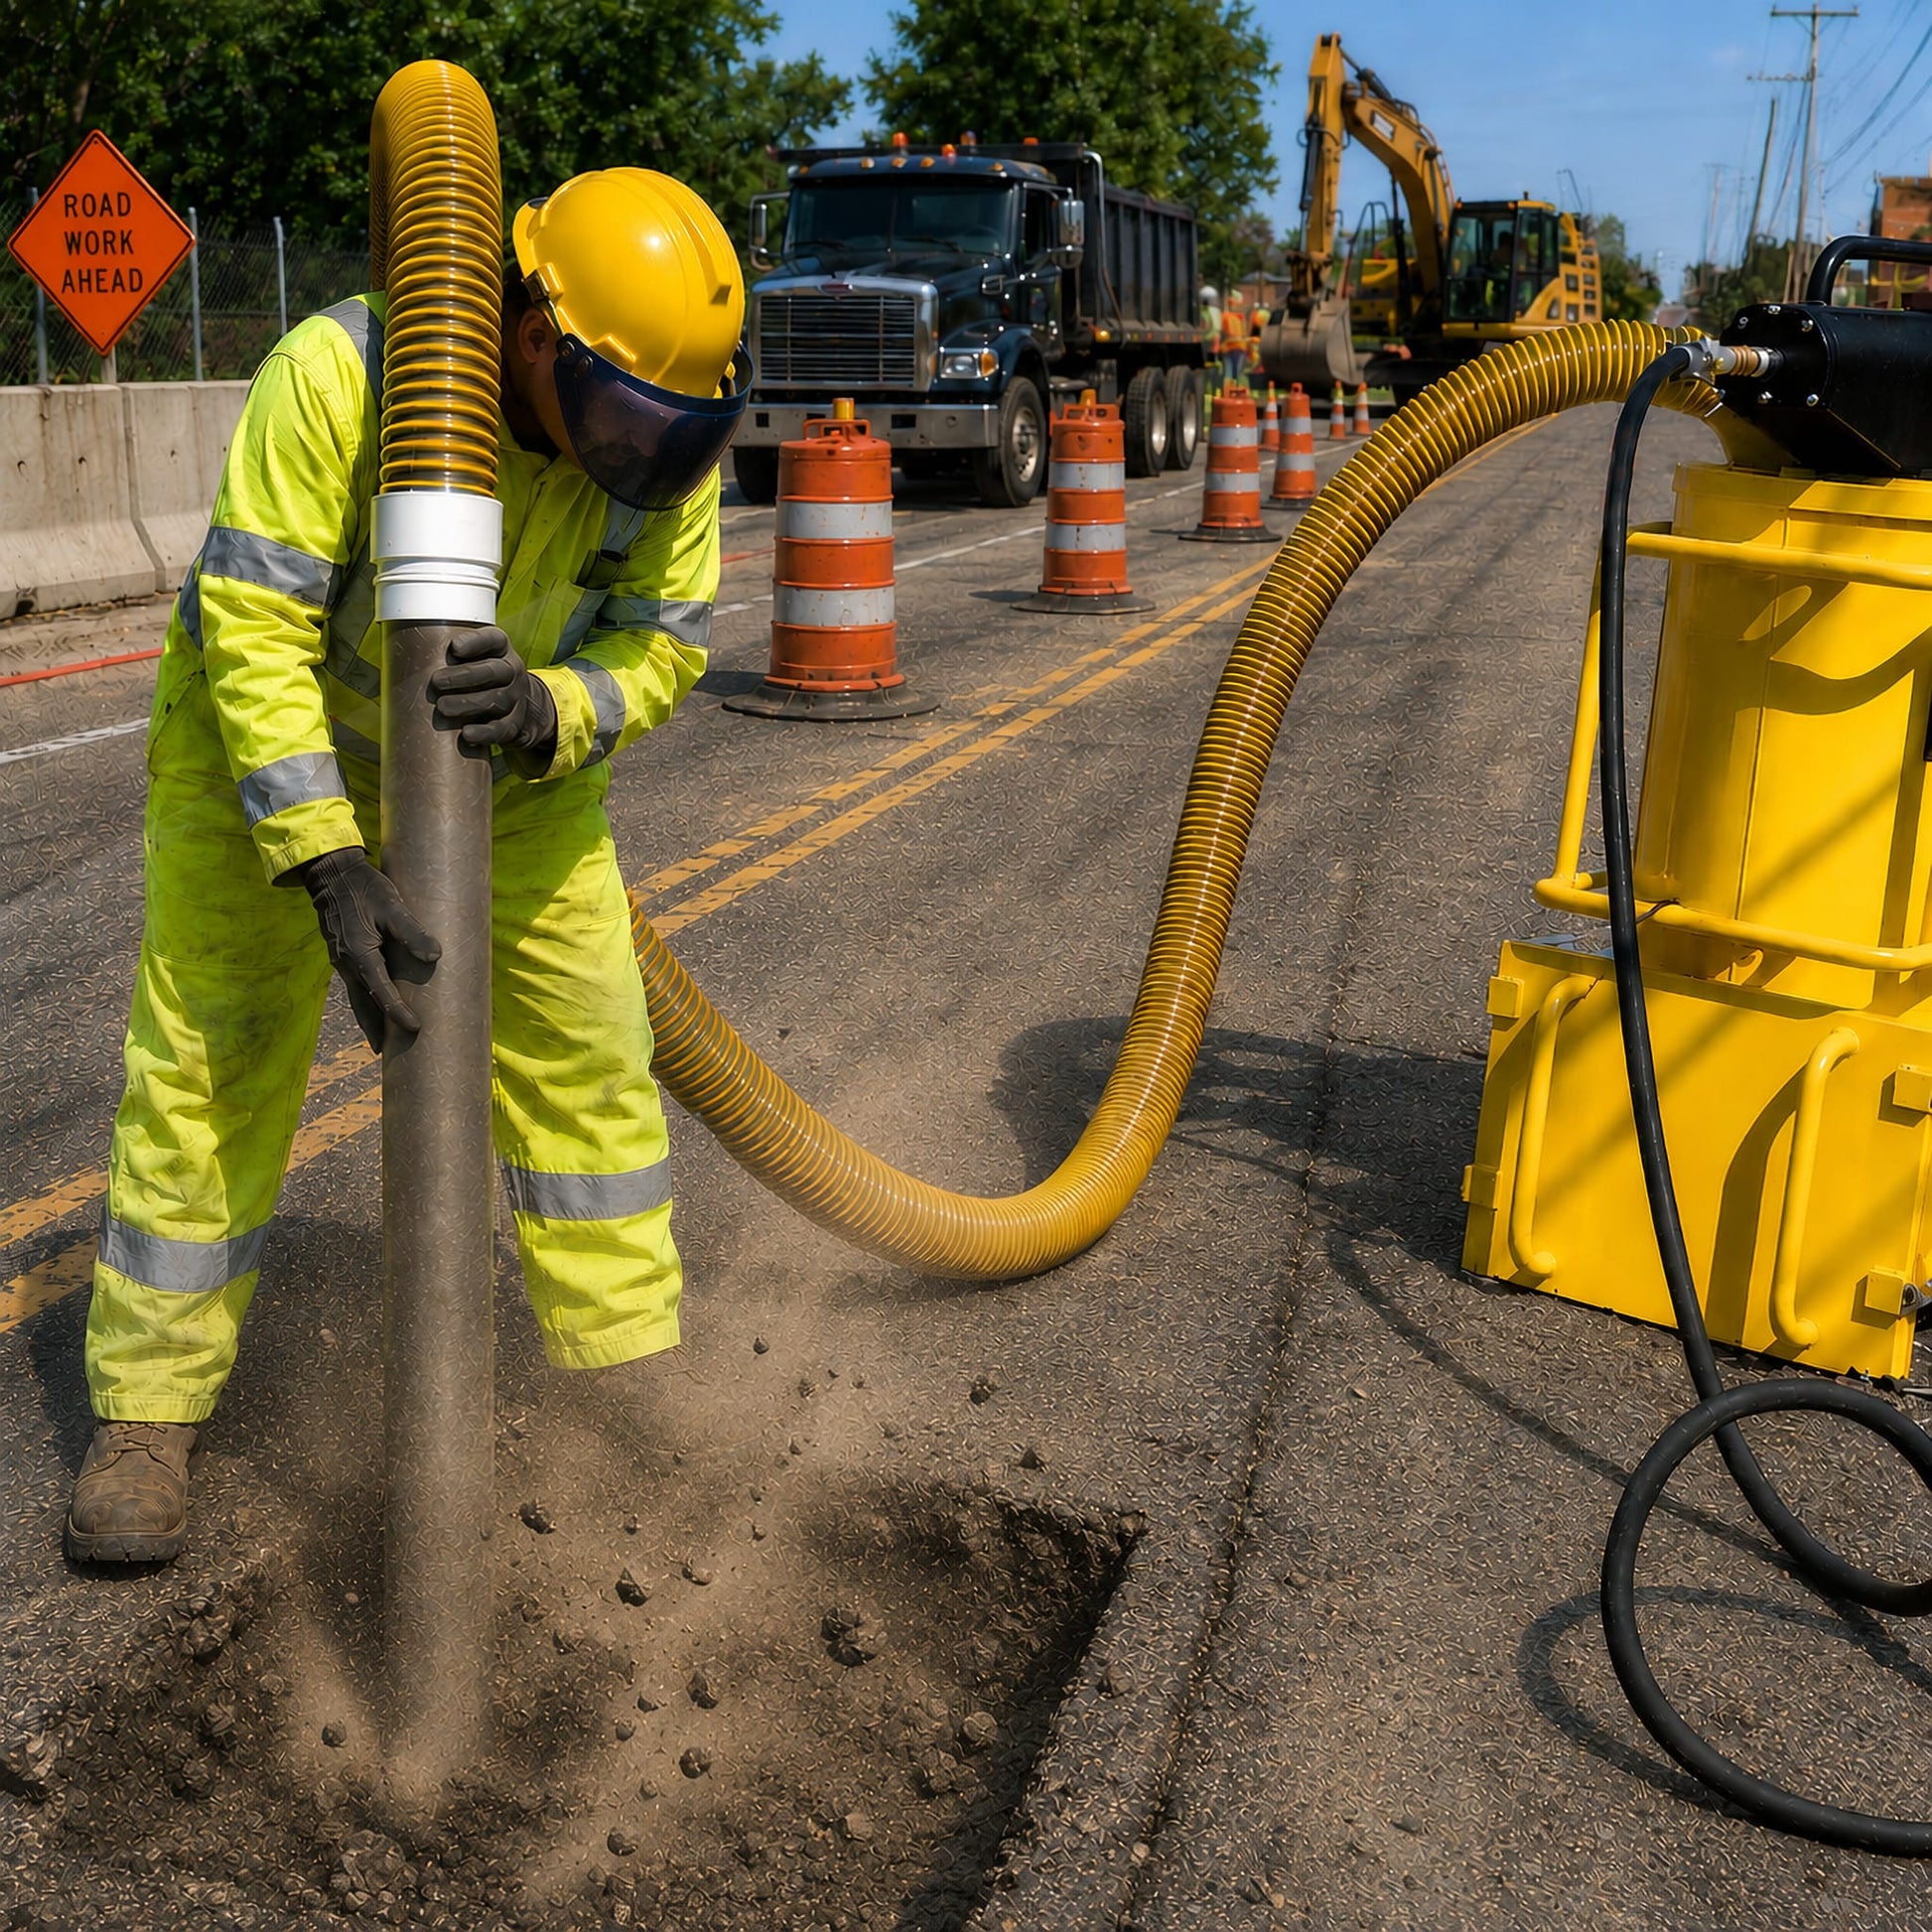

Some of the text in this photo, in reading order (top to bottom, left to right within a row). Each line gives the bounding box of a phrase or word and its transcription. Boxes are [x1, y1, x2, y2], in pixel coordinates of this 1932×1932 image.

[65, 193, 131, 217] ROAD
[65, 230, 134, 255] WORK
[62, 268, 143, 294] AHEAD
